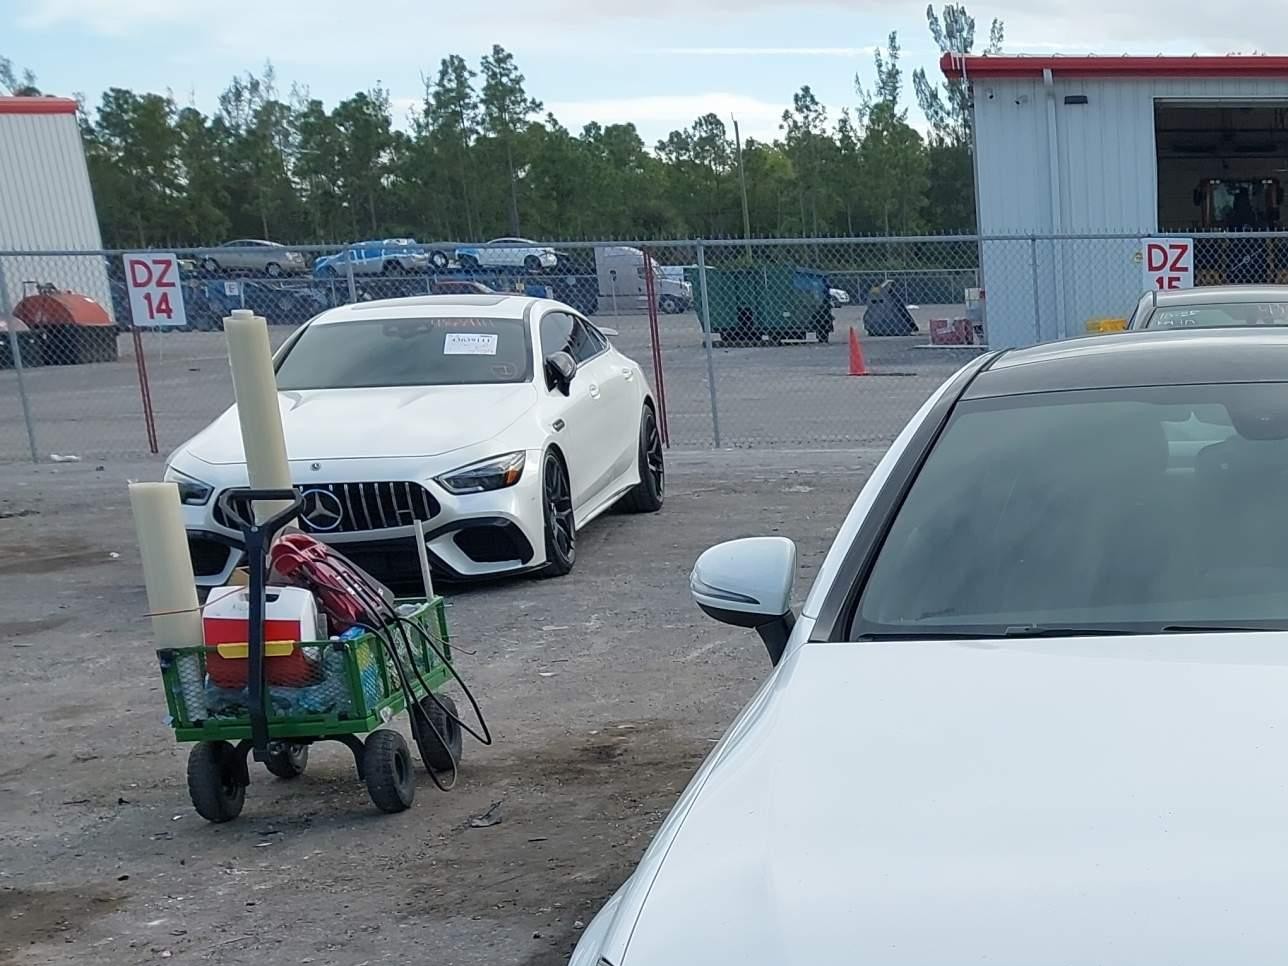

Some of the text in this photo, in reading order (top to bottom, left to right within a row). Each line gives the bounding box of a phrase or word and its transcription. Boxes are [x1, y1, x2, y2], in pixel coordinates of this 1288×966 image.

[1147, 244, 1189, 272] DZ
[129, 260, 176, 288] DZ
[144, 292, 173, 319] 14
